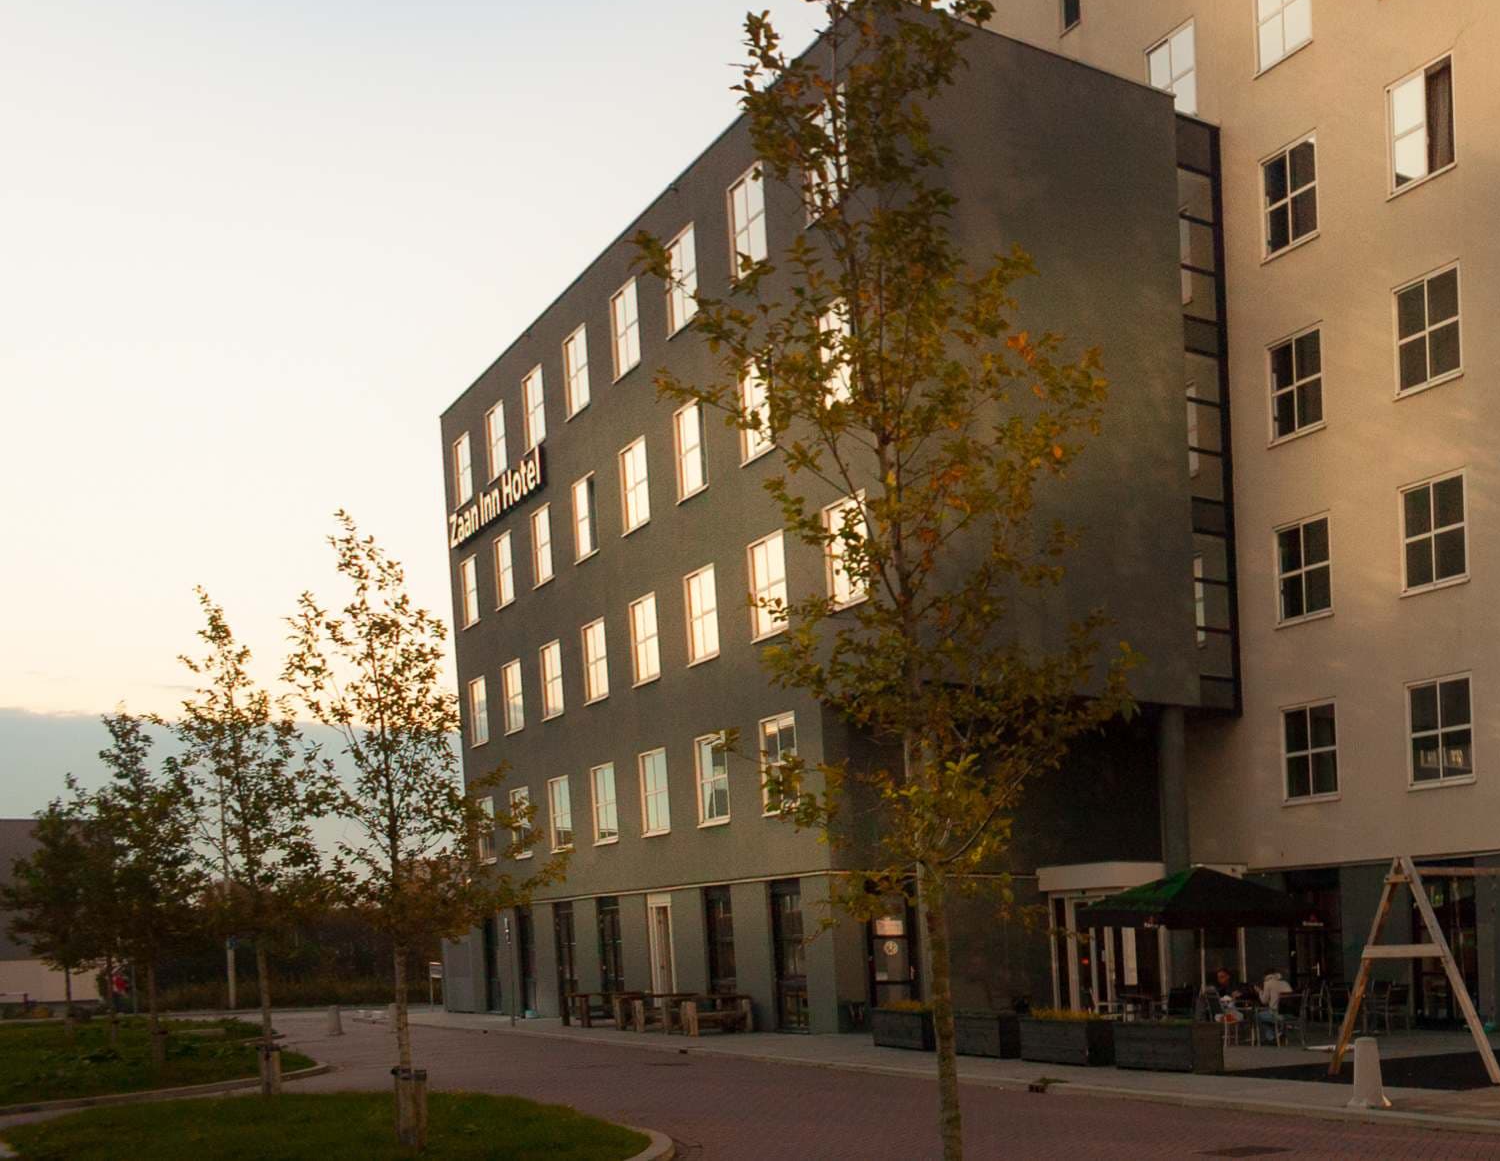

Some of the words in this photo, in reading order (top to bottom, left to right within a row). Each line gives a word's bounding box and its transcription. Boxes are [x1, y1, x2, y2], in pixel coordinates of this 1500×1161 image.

[449, 504, 480, 549] Zaan
[479, 487, 501, 526] Inn
[501, 444, 542, 510] Hotel
